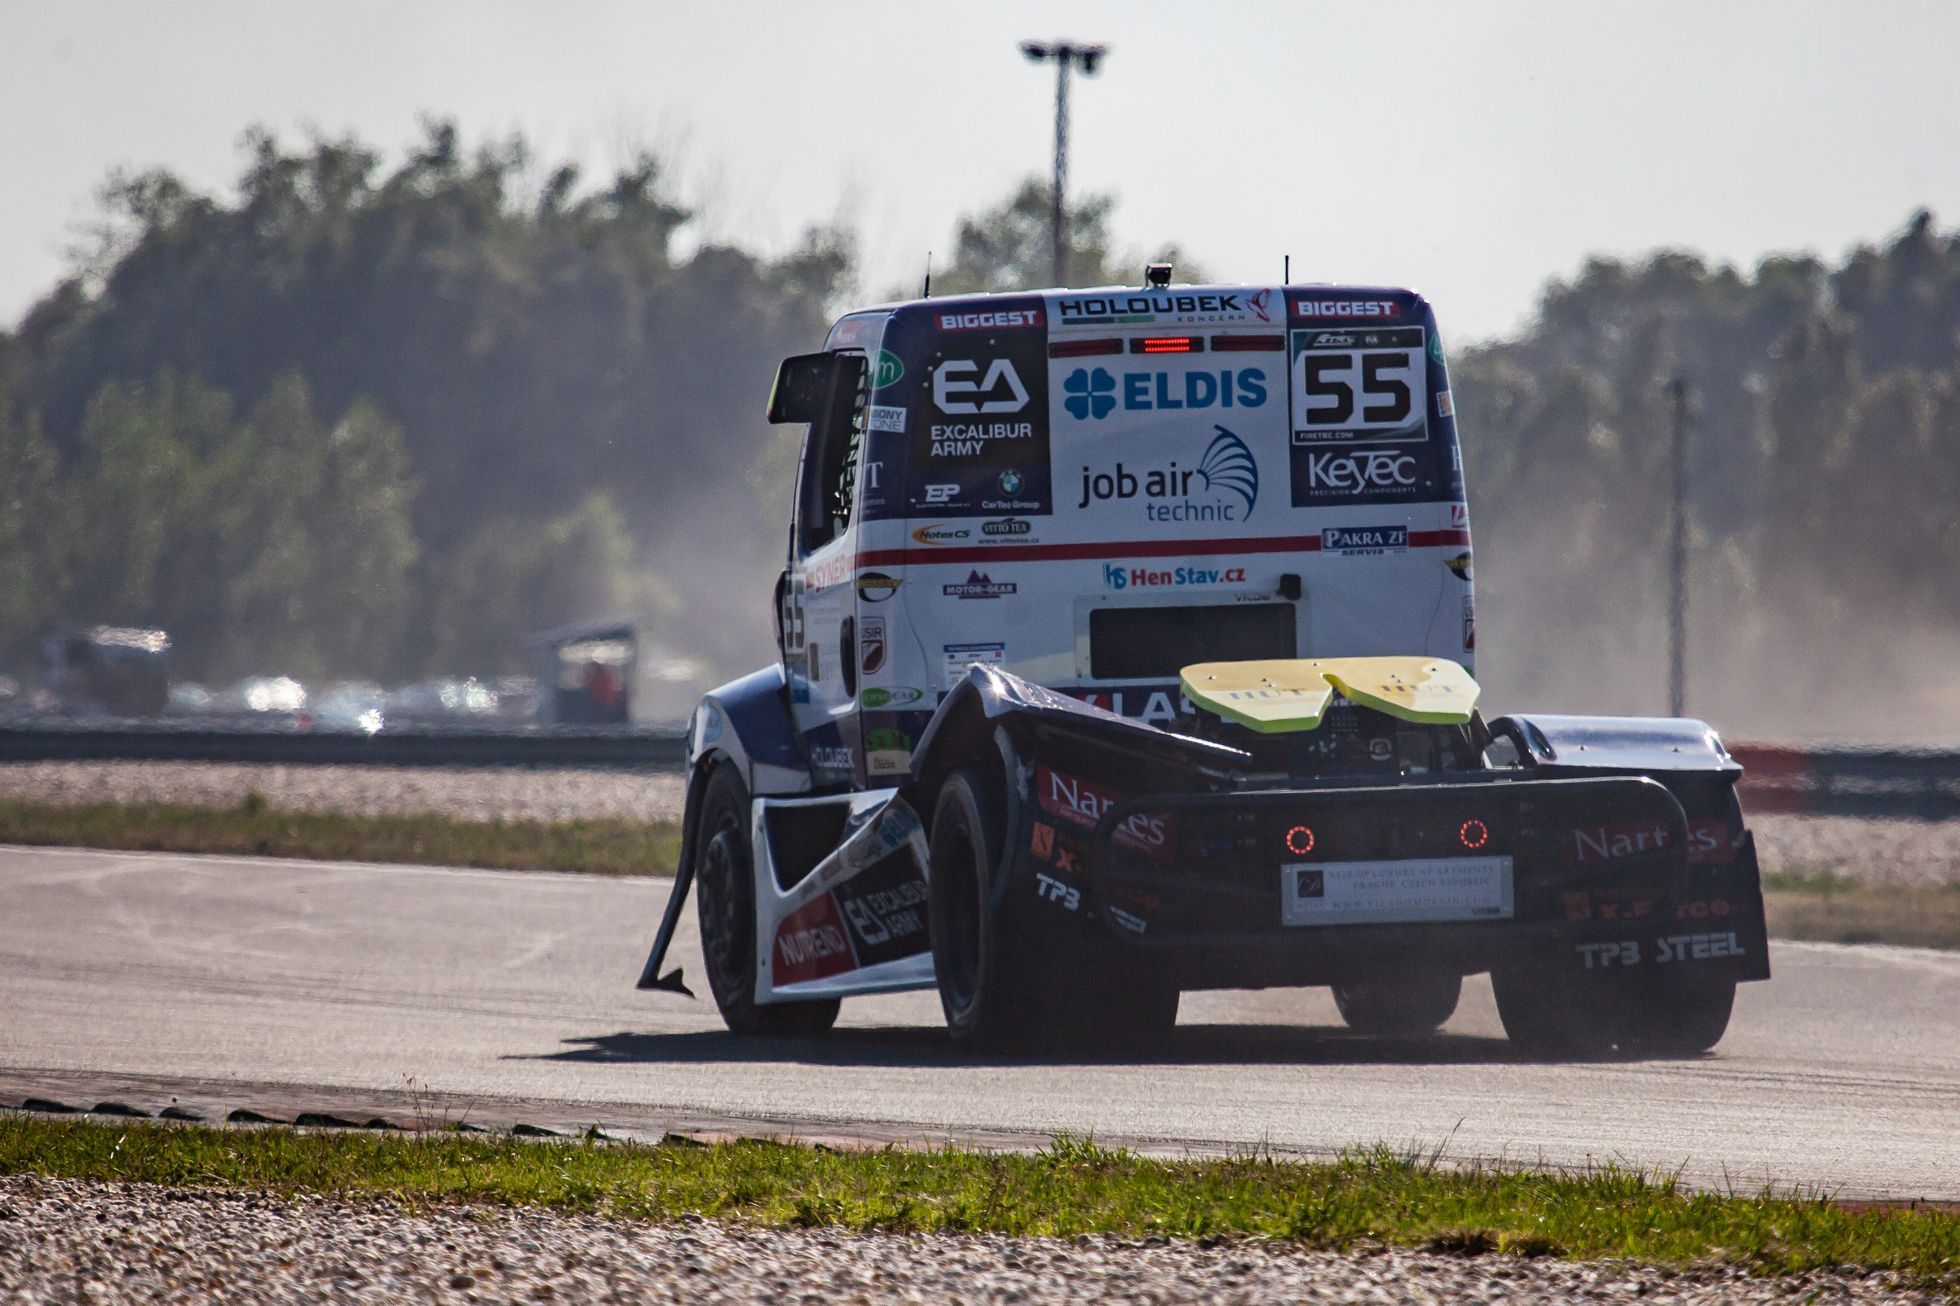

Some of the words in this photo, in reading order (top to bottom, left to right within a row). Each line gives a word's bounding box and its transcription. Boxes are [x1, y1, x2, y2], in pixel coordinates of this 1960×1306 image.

[1059, 295, 1242, 316] HOLOUBEK
[1298, 301, 1393, 316] BIGGEST
[940, 310, 1037, 329] BIGGEST
[1177, 314, 1246, 323] KONCERN
[933, 359, 1030, 415] EA
[1124, 367, 1268, 411] ELDIS
[1304, 353, 1411, 425] 55
[931, 423, 1032, 440] EXCALIBUR
[930, 440, 983, 456] ARMY
[1078, 463, 1138, 509] job
[1145, 462, 1193, 497] air
[1146, 499, 1234, 521] technic
[1325, 530, 1384, 547] PAKRA
[1656, 932, 1746, 963] STEEL
